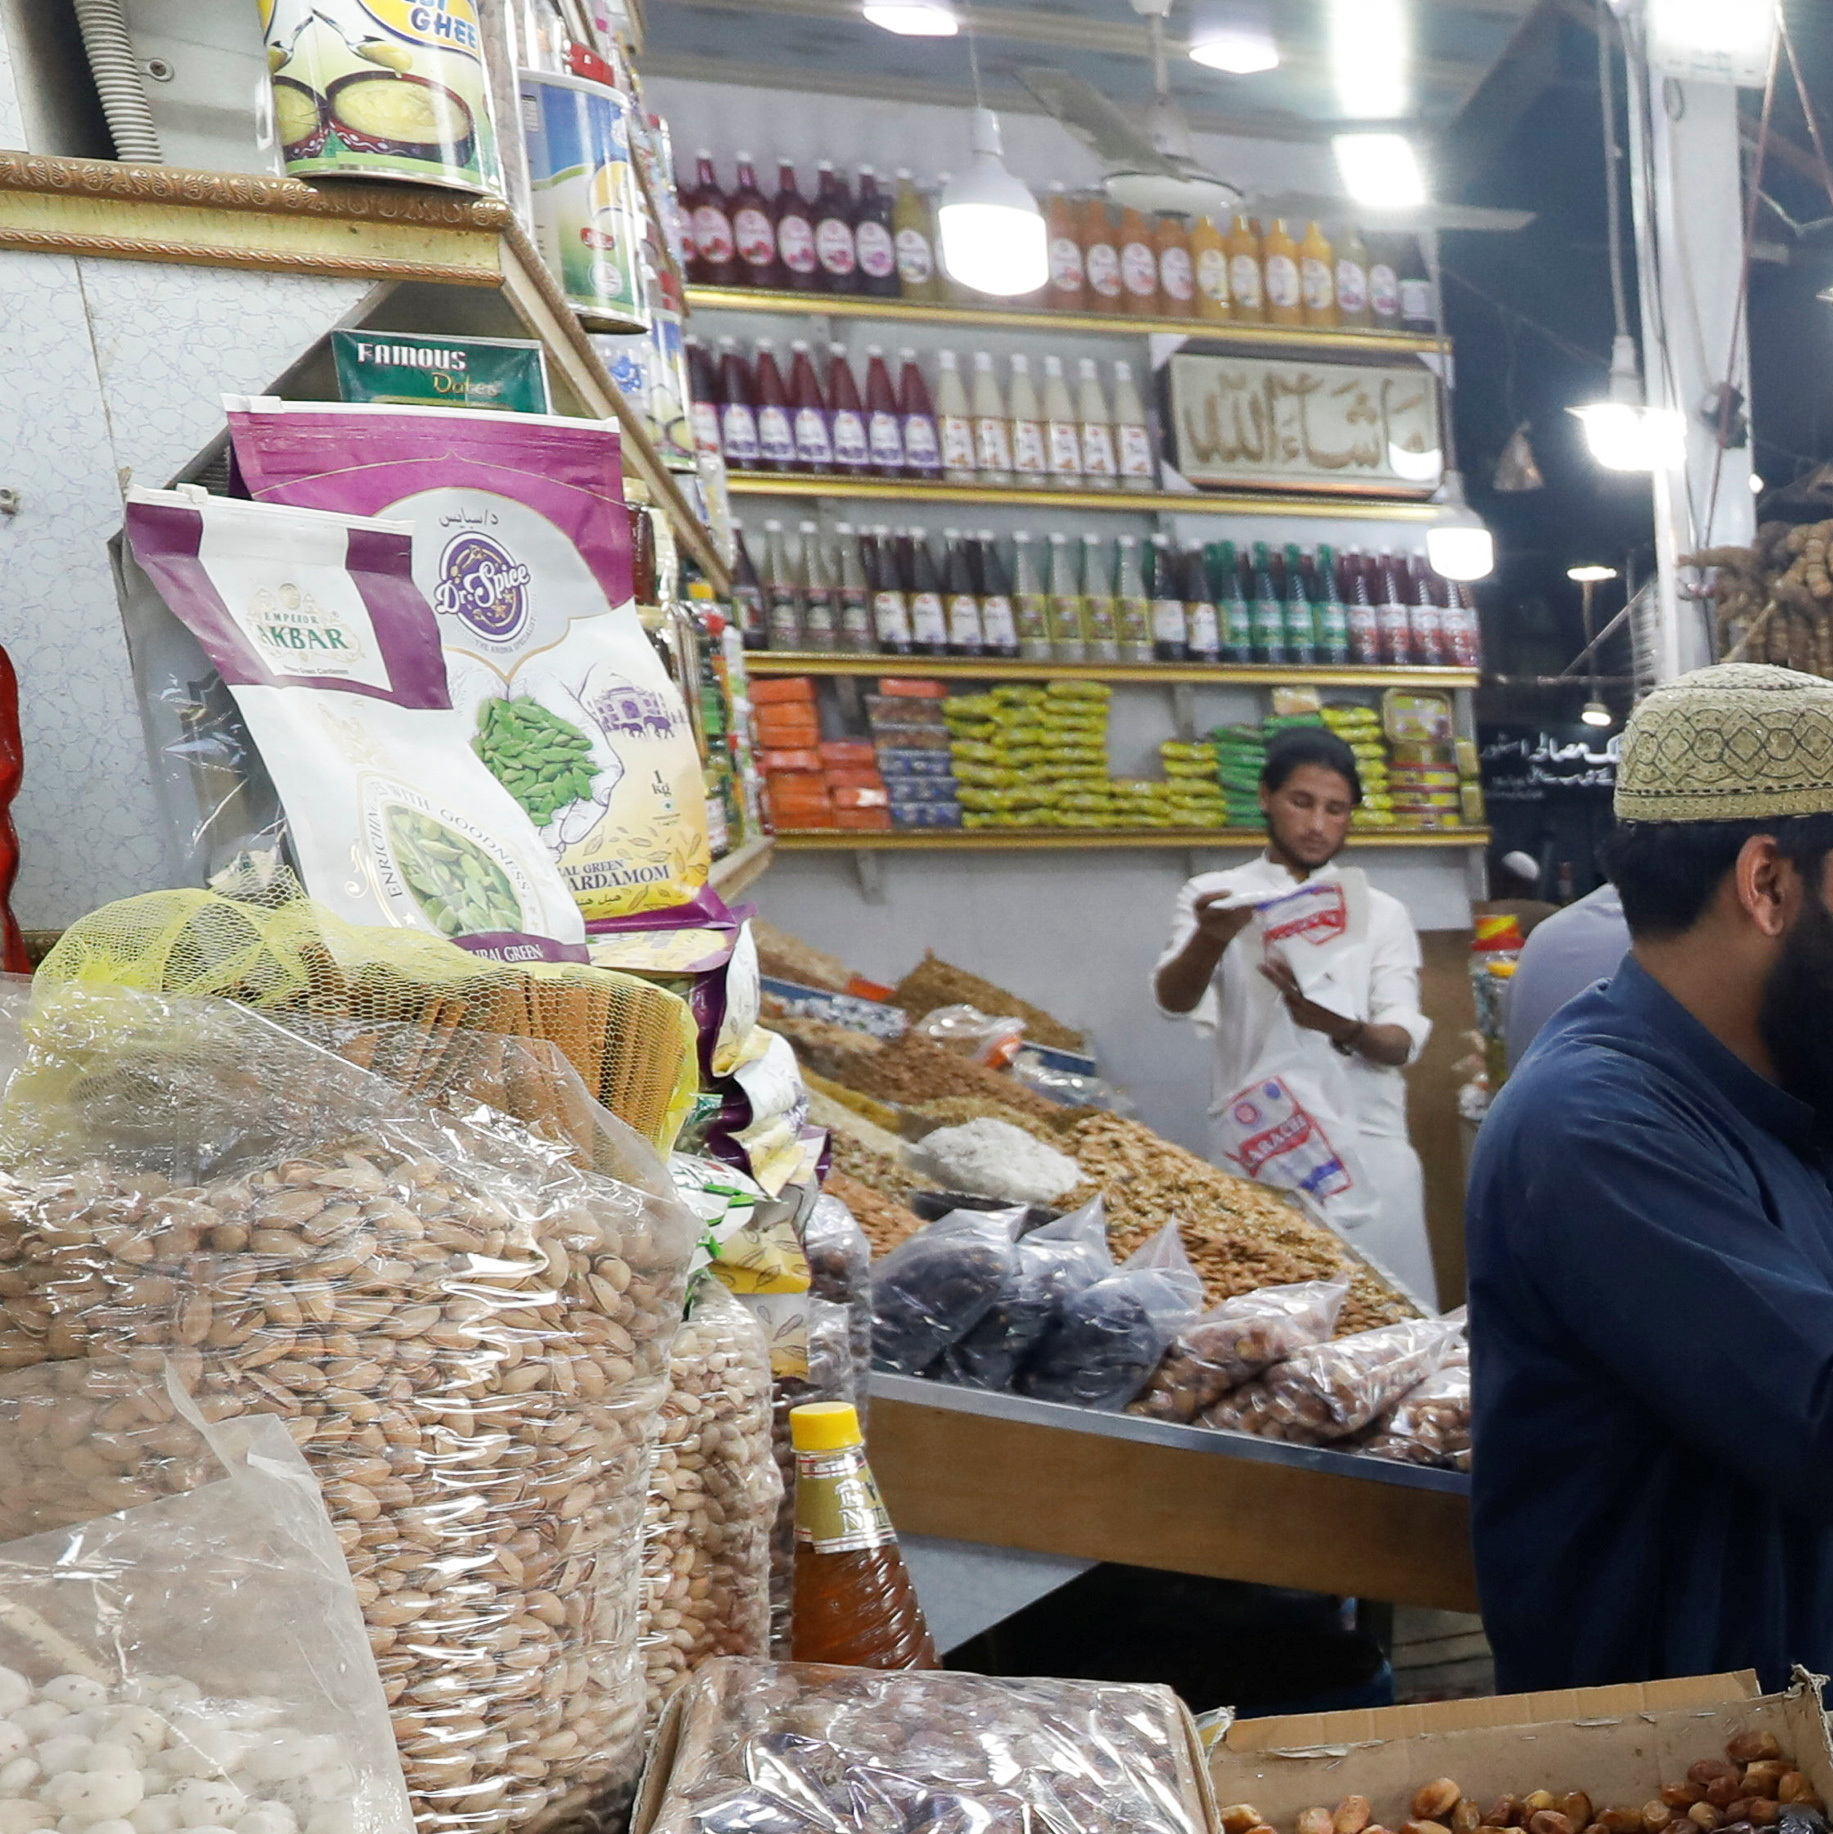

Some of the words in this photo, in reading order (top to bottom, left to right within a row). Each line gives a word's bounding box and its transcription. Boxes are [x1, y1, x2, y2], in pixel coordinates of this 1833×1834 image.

[410, 8, 477, 49] GHEE
[356, 343, 466, 370] FAMOUS
[258, 625, 349, 651] AKBAR
[568, 865, 670, 890] ARDAMOM
